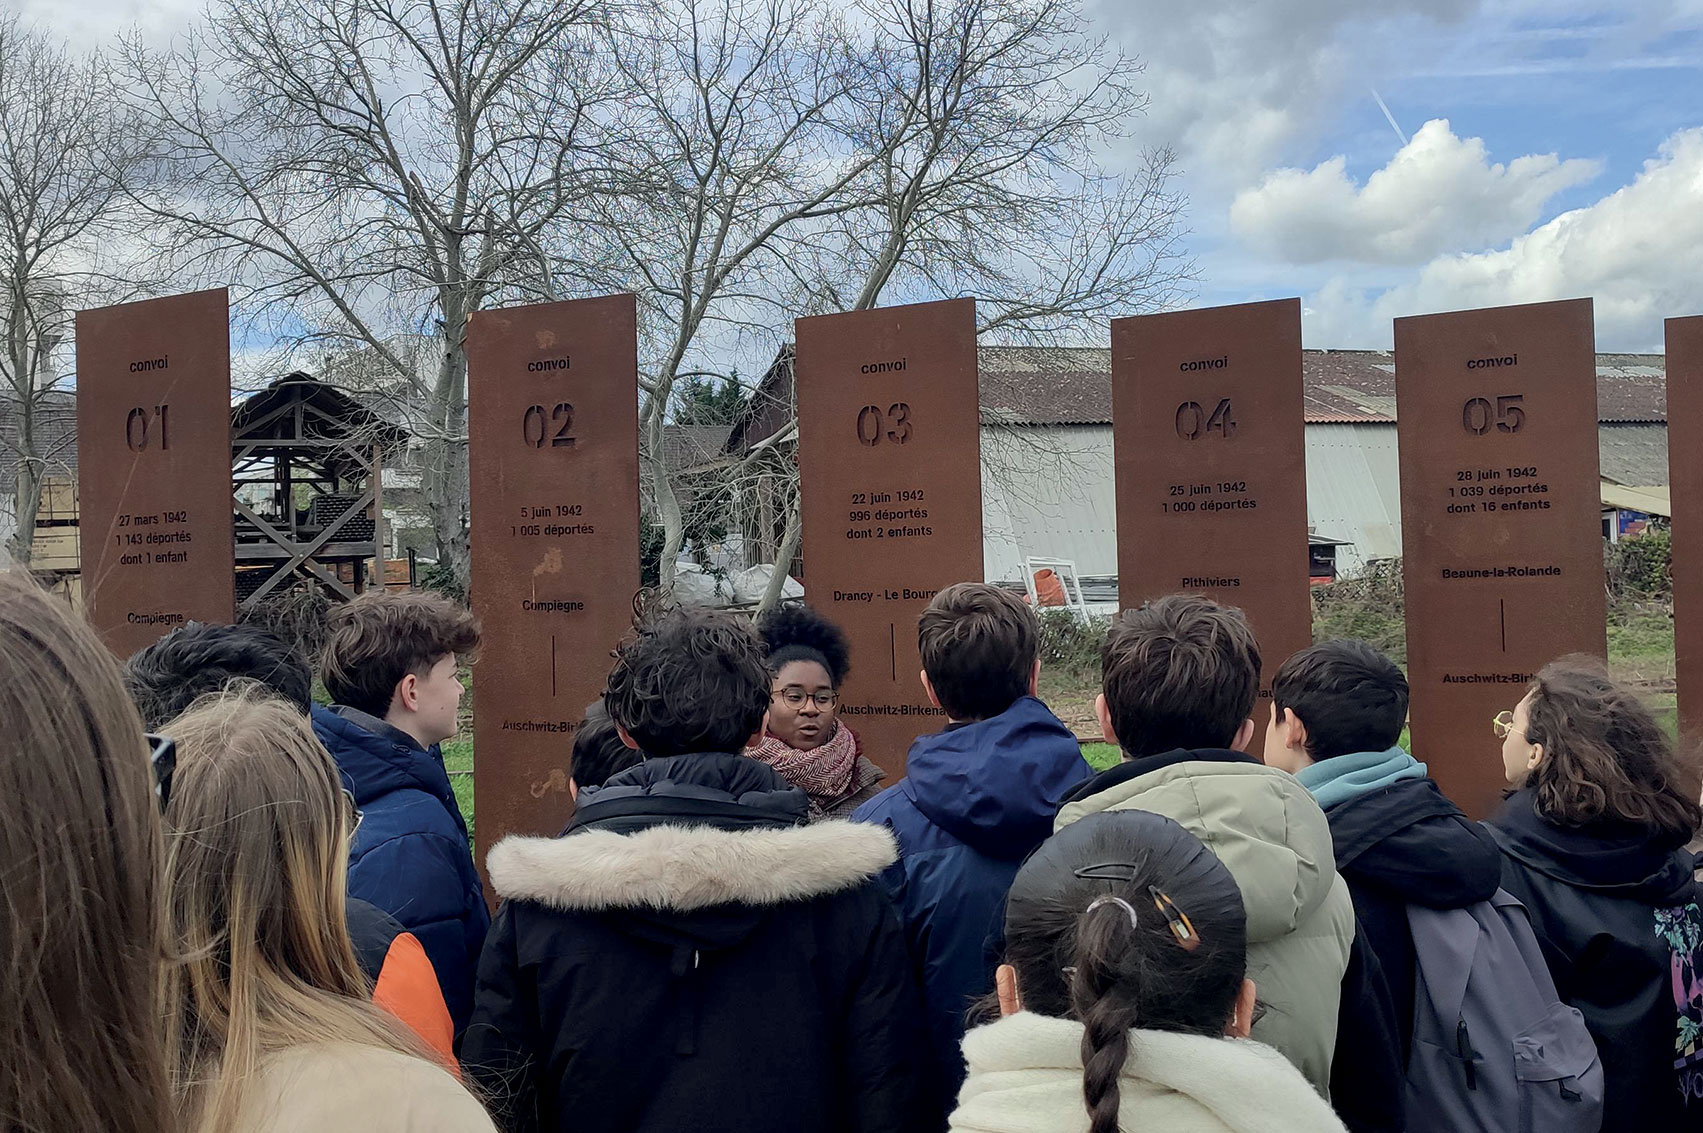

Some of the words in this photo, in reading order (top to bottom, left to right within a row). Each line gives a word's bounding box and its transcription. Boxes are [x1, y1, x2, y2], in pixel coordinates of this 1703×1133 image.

[129, 354, 168, 373] convoi
[527, 355, 570, 372] convoi
[861, 357, 906, 374] convoi
[1180, 355, 1228, 372] convoi
[1467, 353, 1518, 369] convoi
[1175, 398, 1236, 441] 04
[1463, 394, 1525, 436] 05
[126, 404, 169, 452] 01
[523, 402, 576, 449] 02
[857, 402, 913, 447] 03
[1457, 470, 1473, 481] 28
[1477, 469, 1500, 482] juin
[1506, 466, 1537, 478] 1942
[852, 493, 866, 505] 22
[870, 492, 891, 505] juin
[896, 489, 924, 501] 1942
[1170, 485, 1185, 496] 25
[1189, 484, 1211, 497] juin
[1217, 481, 1246, 493] 1942
[1448, 487, 1454, 498] 1
[1460, 486, 1484, 497] 039
[1488, 483, 1549, 496] déportés
[520, 506, 528, 518] 5
[531, 506, 552, 520] juin
[555, 504, 582, 517] 1942
[1162, 502, 1168, 513] 1
[1173, 501, 1196, 512] 000
[1200, 498, 1257, 512] déportés
[1447, 503, 1476, 514] dont
[1481, 501, 1497, 512] 16
[1501, 499, 1551, 511] enfants
[119, 514, 130, 527] 27
[134, 514, 159, 526] mars
[162, 510, 188, 523] 1942
[849, 510, 871, 522] 996
[875, 507, 928, 522] déportés
[116, 534, 121, 546] 1
[126, 533, 143, 546] 143
[146, 530, 192, 545] déportés
[510, 525, 516, 537] 1
[520, 525, 541, 536] 005
[544, 522, 594, 538] déportés
[846, 528, 873, 539] dont
[876, 527, 884, 538] 2
[888, 525, 933, 538] enfants
[120, 553, 143, 565] dont
[146, 552, 151, 564] 1
[155, 551, 188, 563] enfant
[1442, 565, 1561, 579] Beaune-la-Rolande
[1182, 577, 1241, 588] Pithiviers
[833, 590, 874, 603] Drancy
[884, 589, 899, 600] Le
[522, 599, 584, 613] Compiègne
[127, 611, 184, 626] Compiègne
[1442, 673, 1537, 684] Auschwitz-Bir
[840, 703, 946, 716] Auschwitz-Birkena
[502, 719, 578, 733] Auschwitz-Bir
